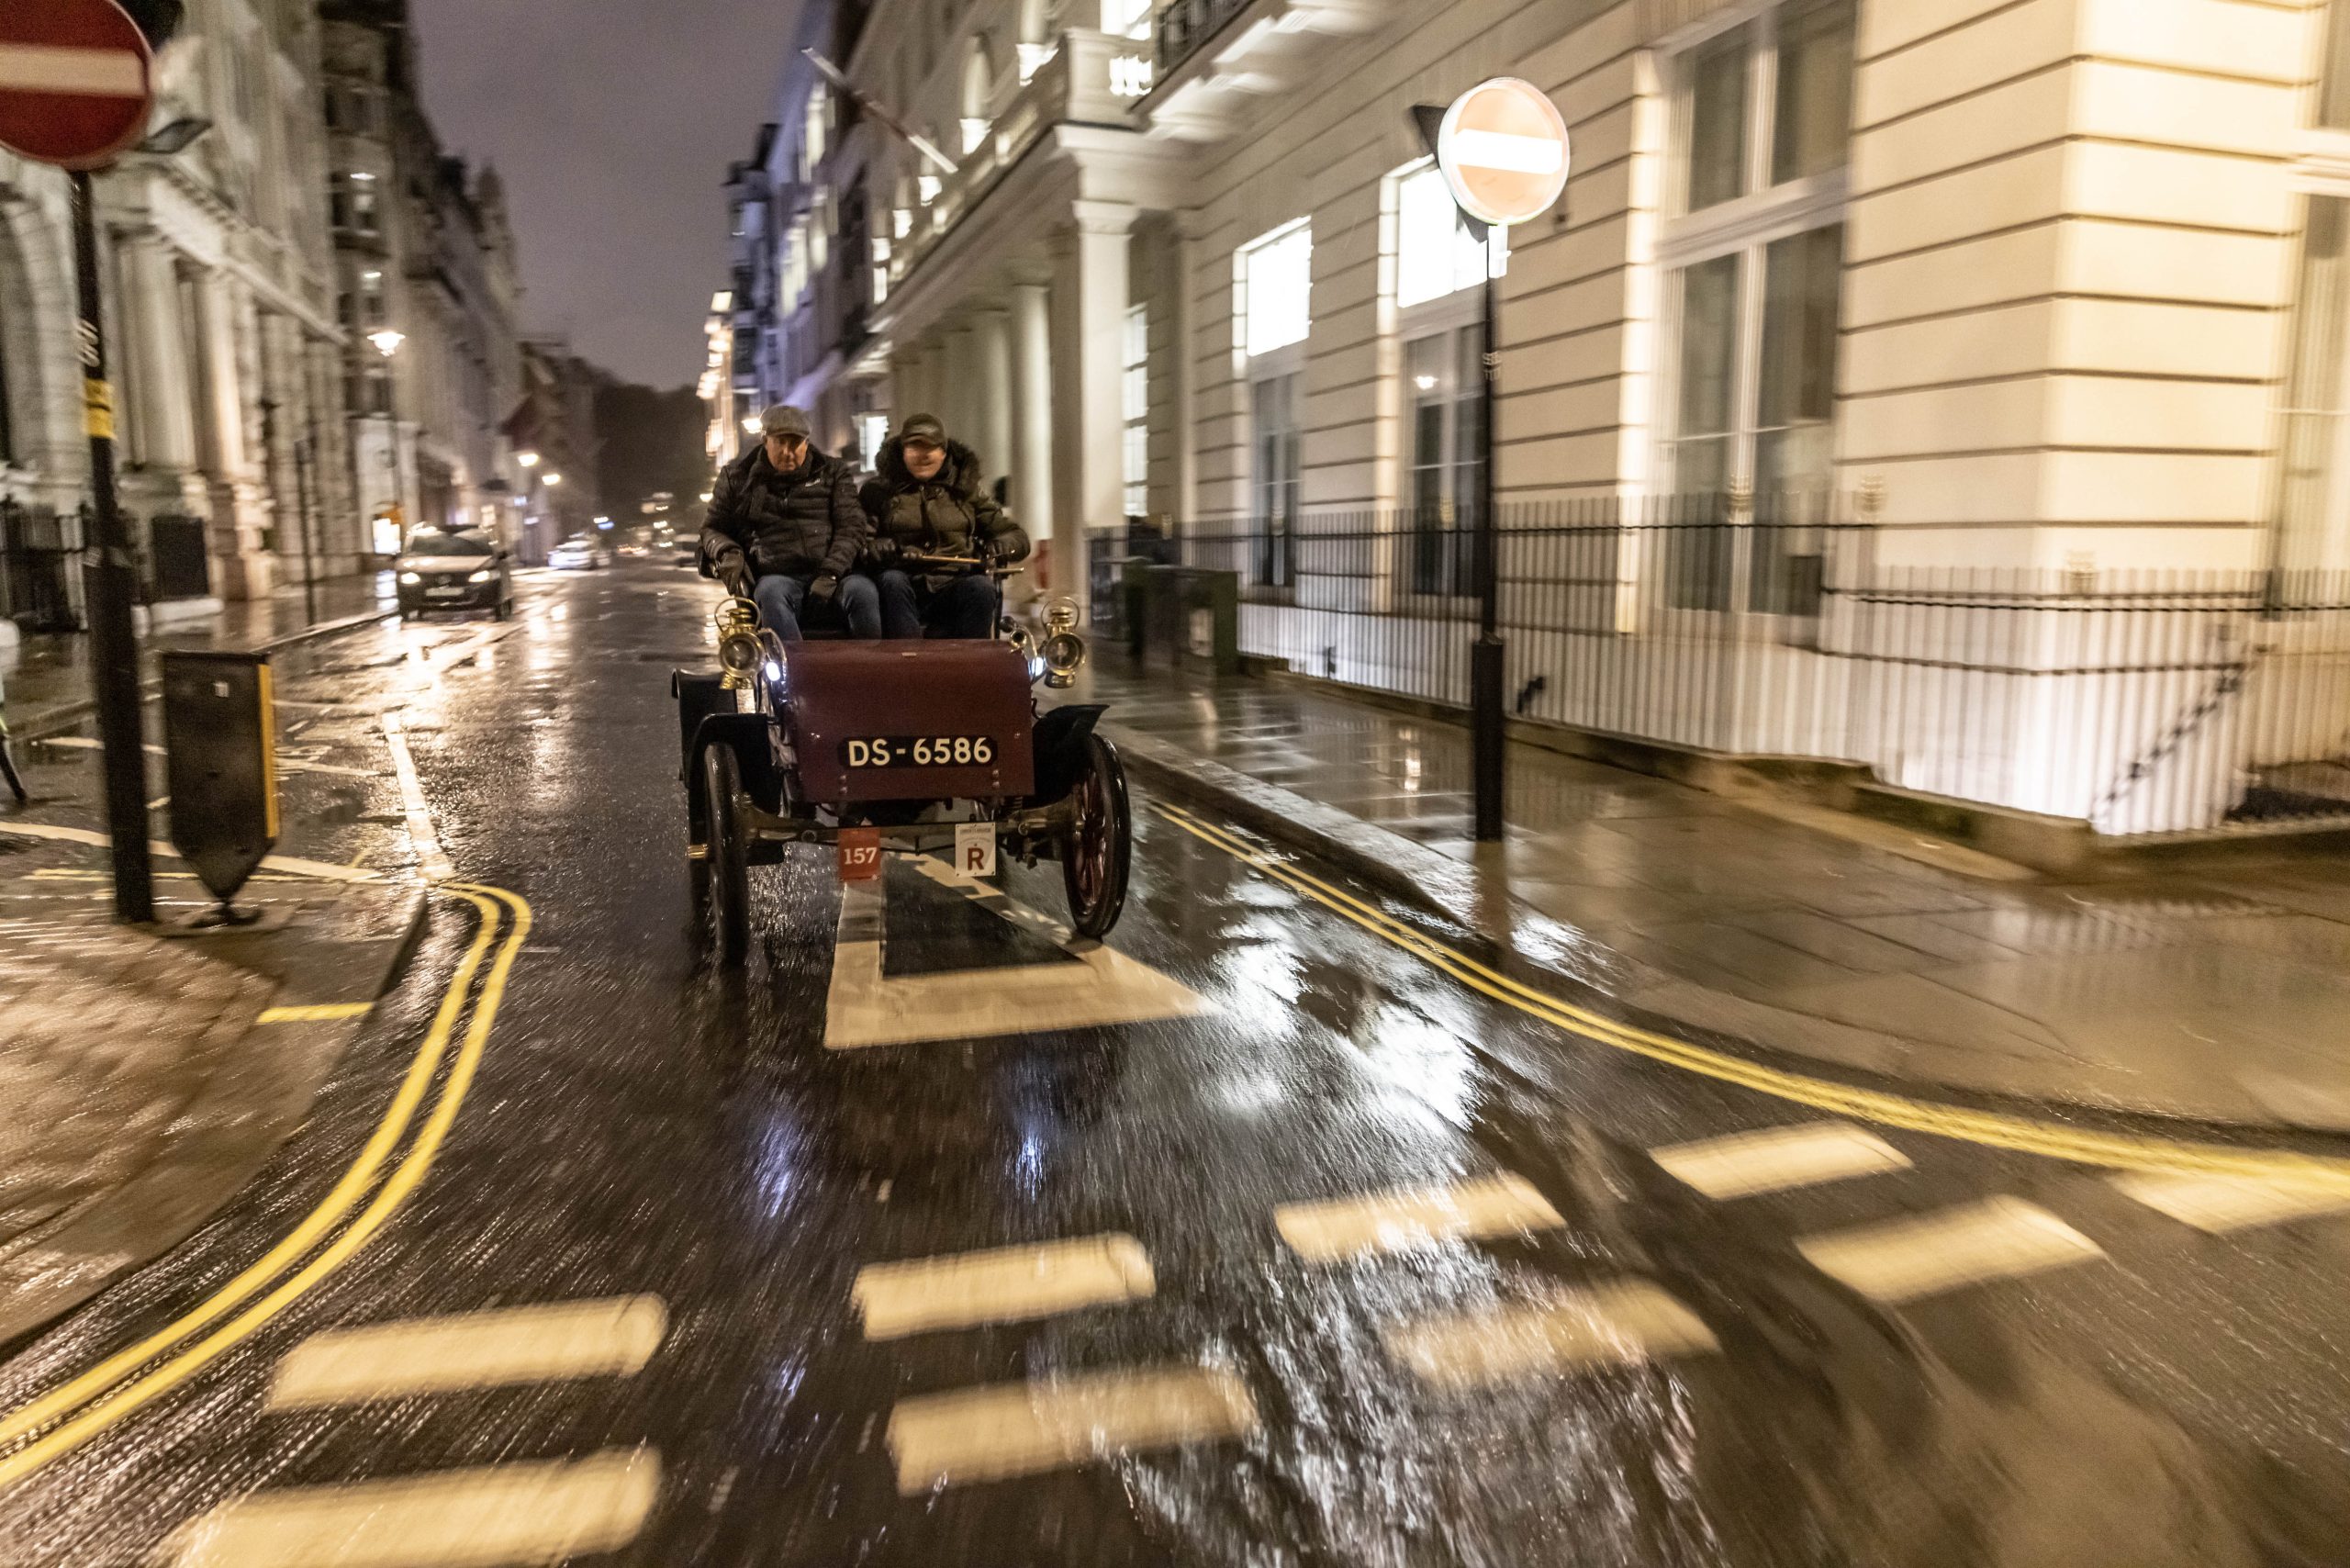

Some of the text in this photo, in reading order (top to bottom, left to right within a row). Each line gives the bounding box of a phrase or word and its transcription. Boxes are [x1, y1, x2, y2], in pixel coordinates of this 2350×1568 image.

[848, 737, 991, 767] DS-6586
[844, 846, 878, 865] 157
[967, 846, 985, 871] R
